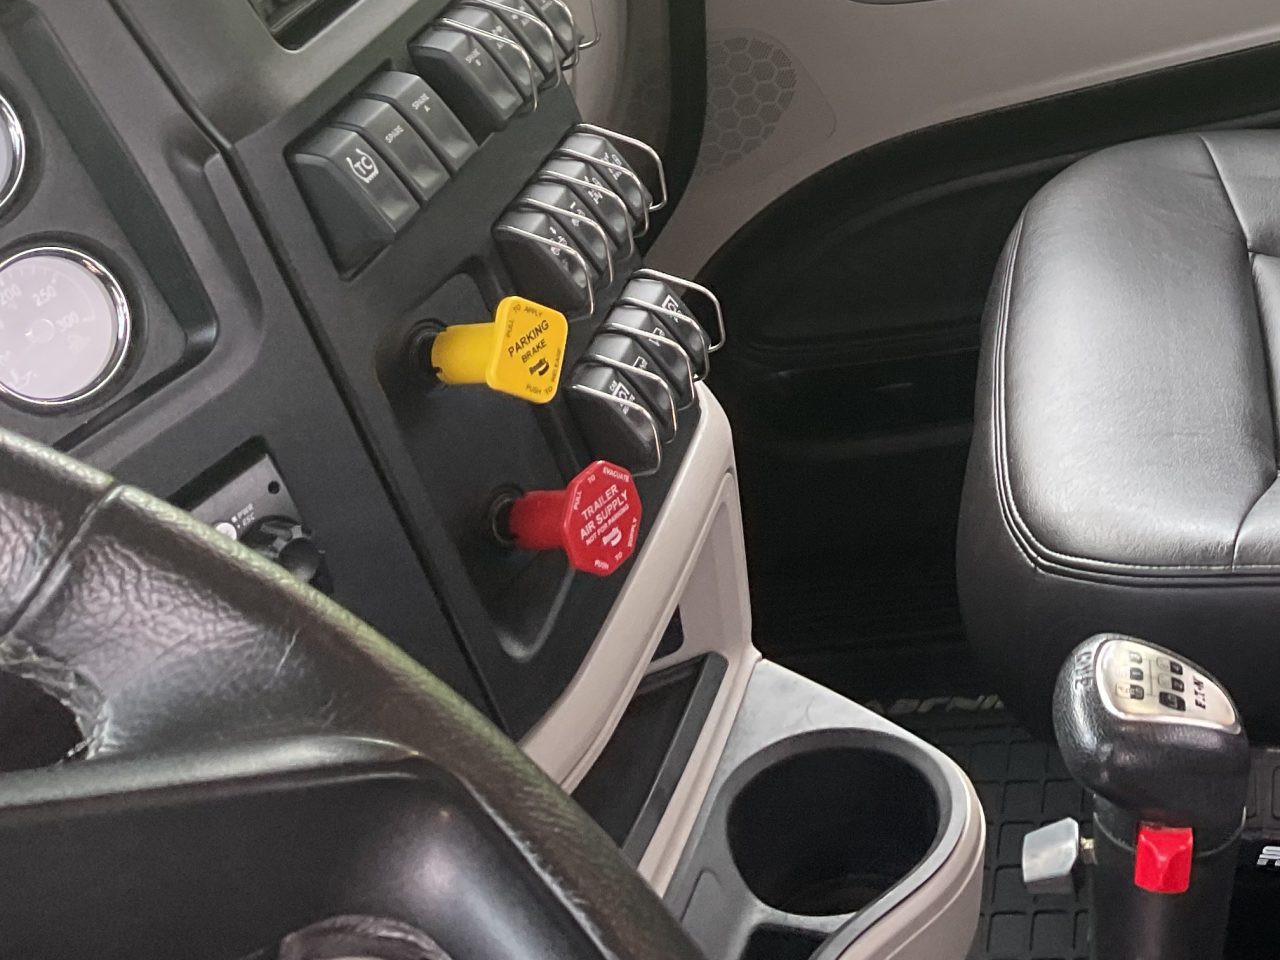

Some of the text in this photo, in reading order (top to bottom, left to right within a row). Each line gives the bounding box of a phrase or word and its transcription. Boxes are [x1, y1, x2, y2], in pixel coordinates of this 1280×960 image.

[354, 156, 373, 174] TC
[508, 320, 549, 358] PARKING
[521, 339, 547, 363] BRAKE
[573, 467, 630, 510] PULL TO EVACUATE
[581, 484, 619, 520] TRAILER
[580, 489, 628, 540] AIR SUPPLY
[586, 532, 597, 546] NOT
